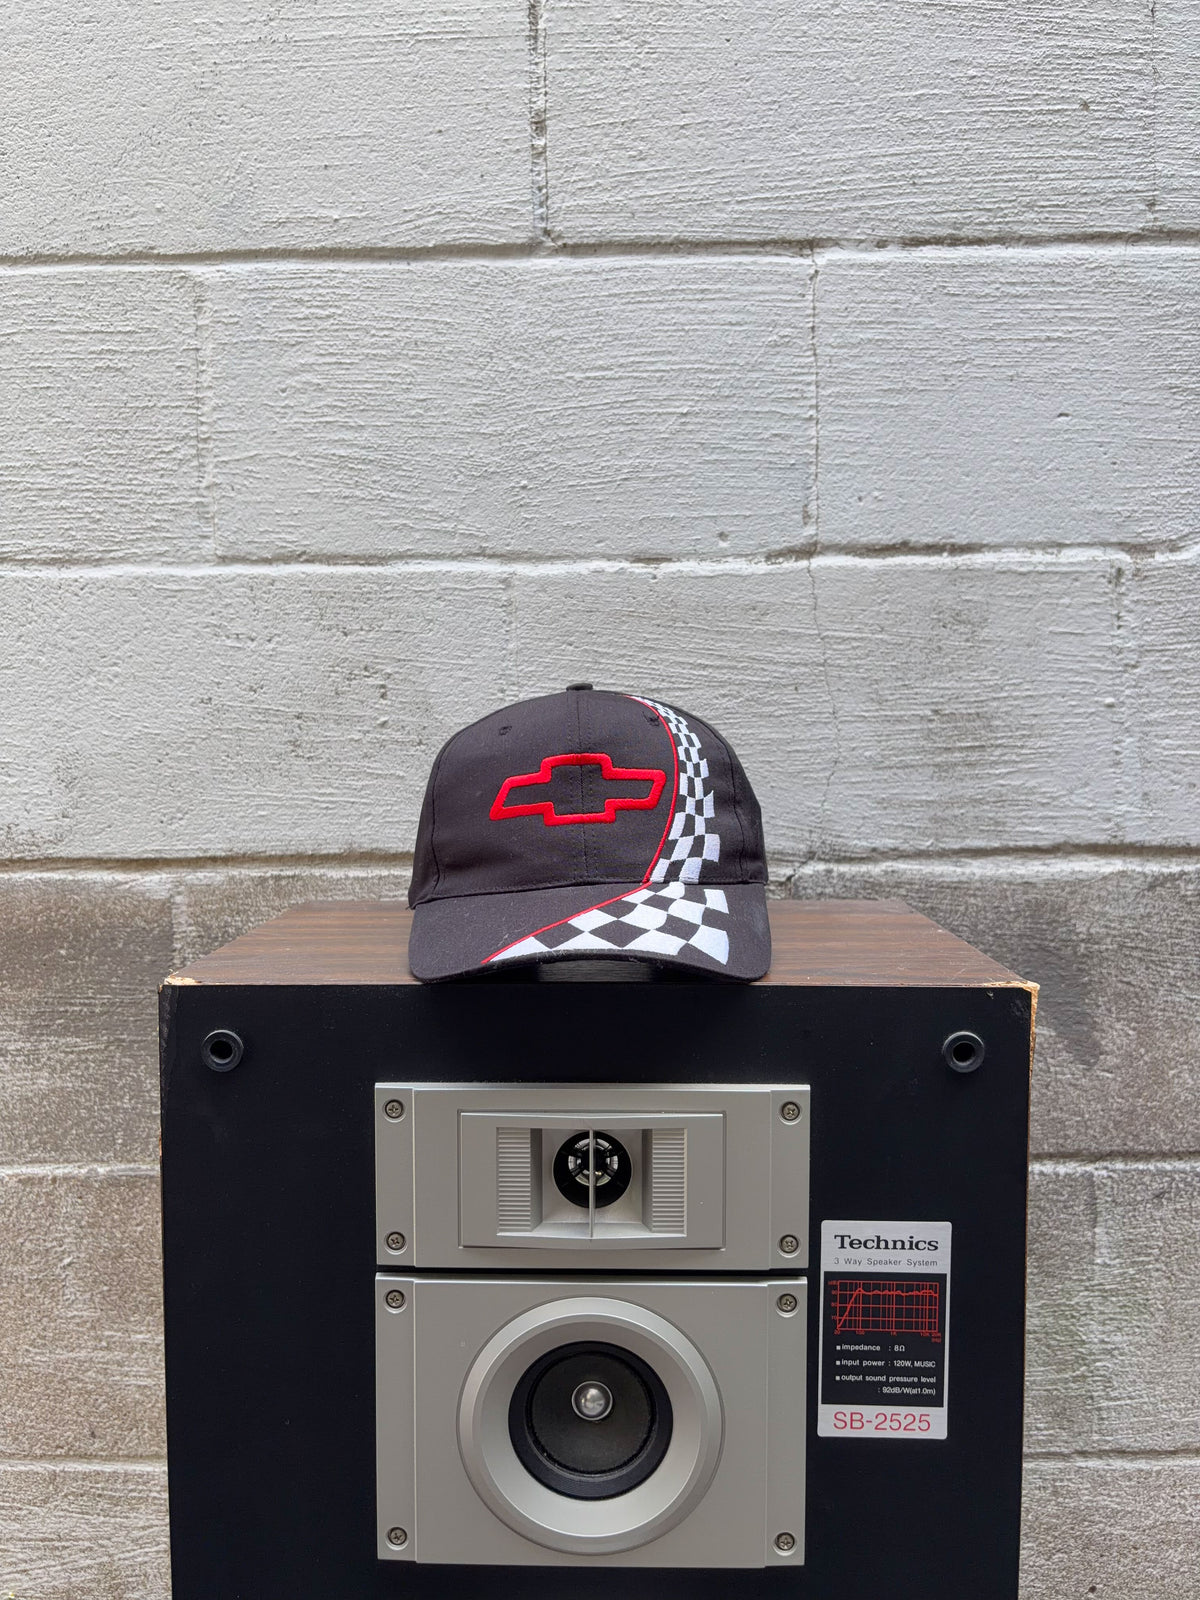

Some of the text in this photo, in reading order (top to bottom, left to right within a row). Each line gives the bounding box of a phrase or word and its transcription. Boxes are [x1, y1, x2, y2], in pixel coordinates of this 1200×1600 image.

[834, 1234, 939, 1251] Technics
[844, 1258, 862, 1266] Way
[867, 1258, 901, 1266] Speaker
[907, 1258, 938, 1267] System
[833, 1411, 931, 1432] SB-2525
